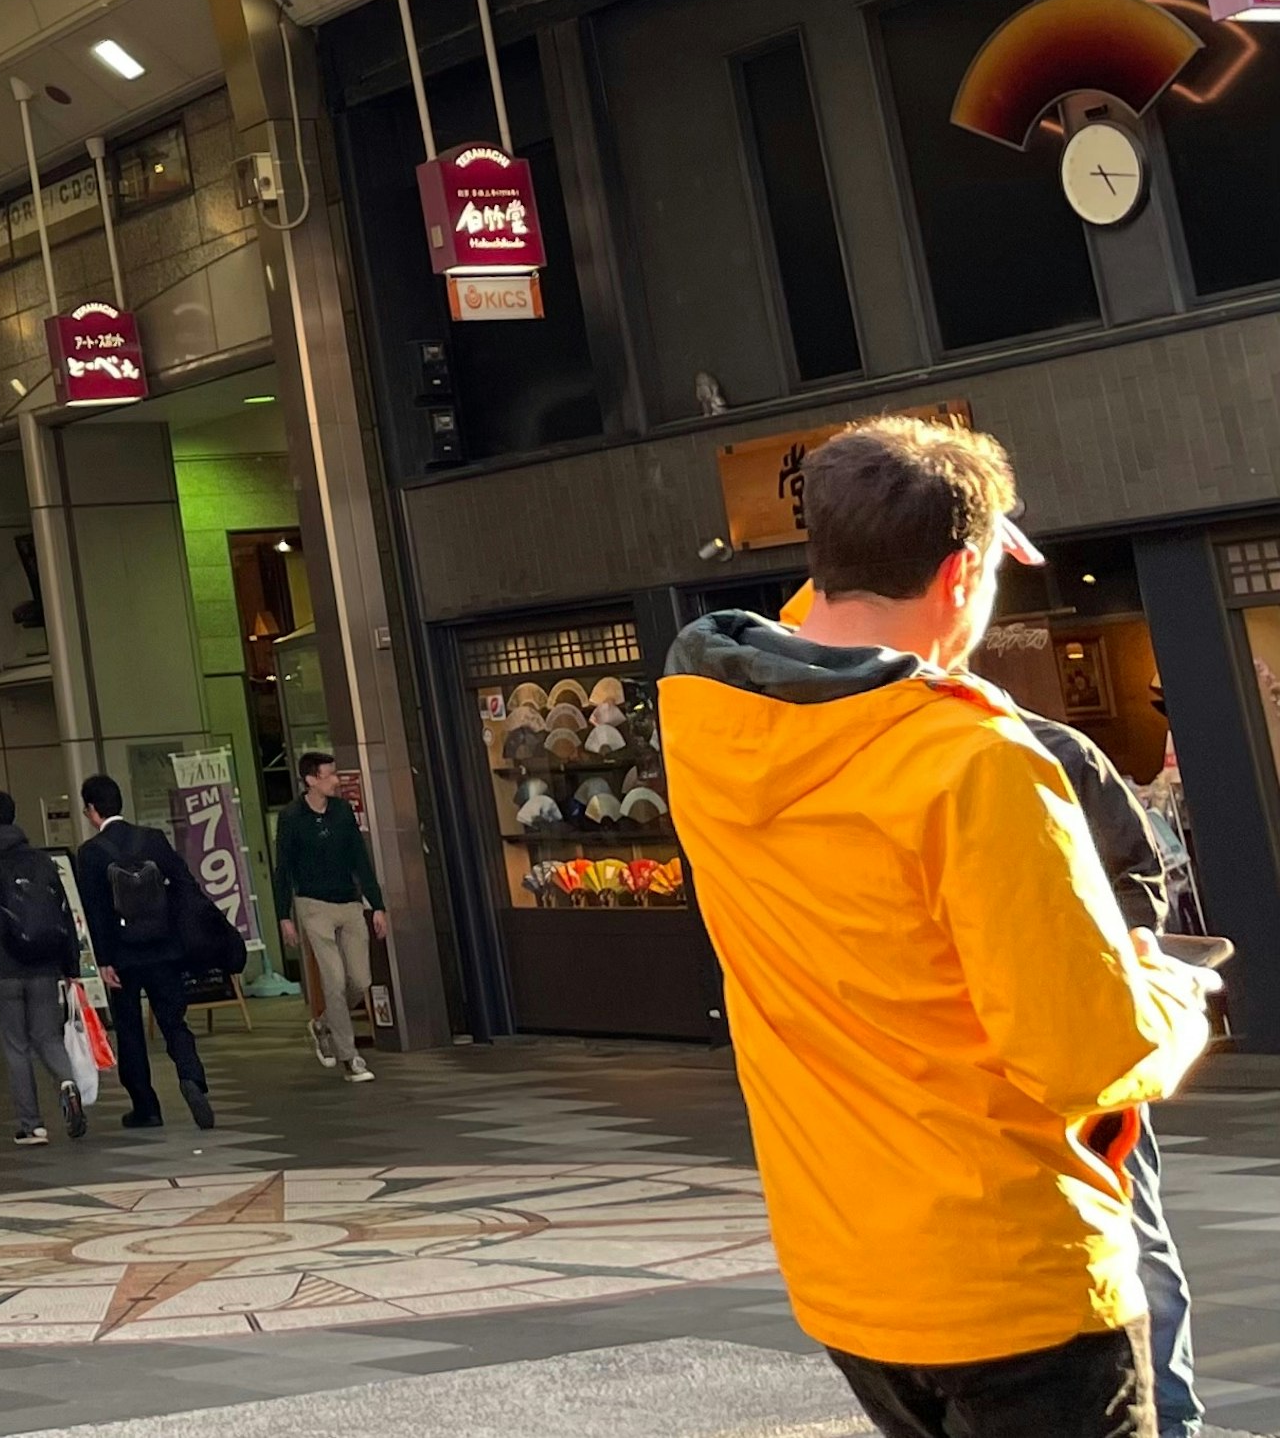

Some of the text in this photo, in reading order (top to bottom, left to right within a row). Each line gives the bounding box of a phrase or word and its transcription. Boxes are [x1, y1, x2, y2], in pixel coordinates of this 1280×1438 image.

[455, 148, 511, 168] TERAMACHI
[455, 199, 529, 234] 白竹堂
[484, 290, 527, 309] KICS
[185, 786, 220, 813] FM
